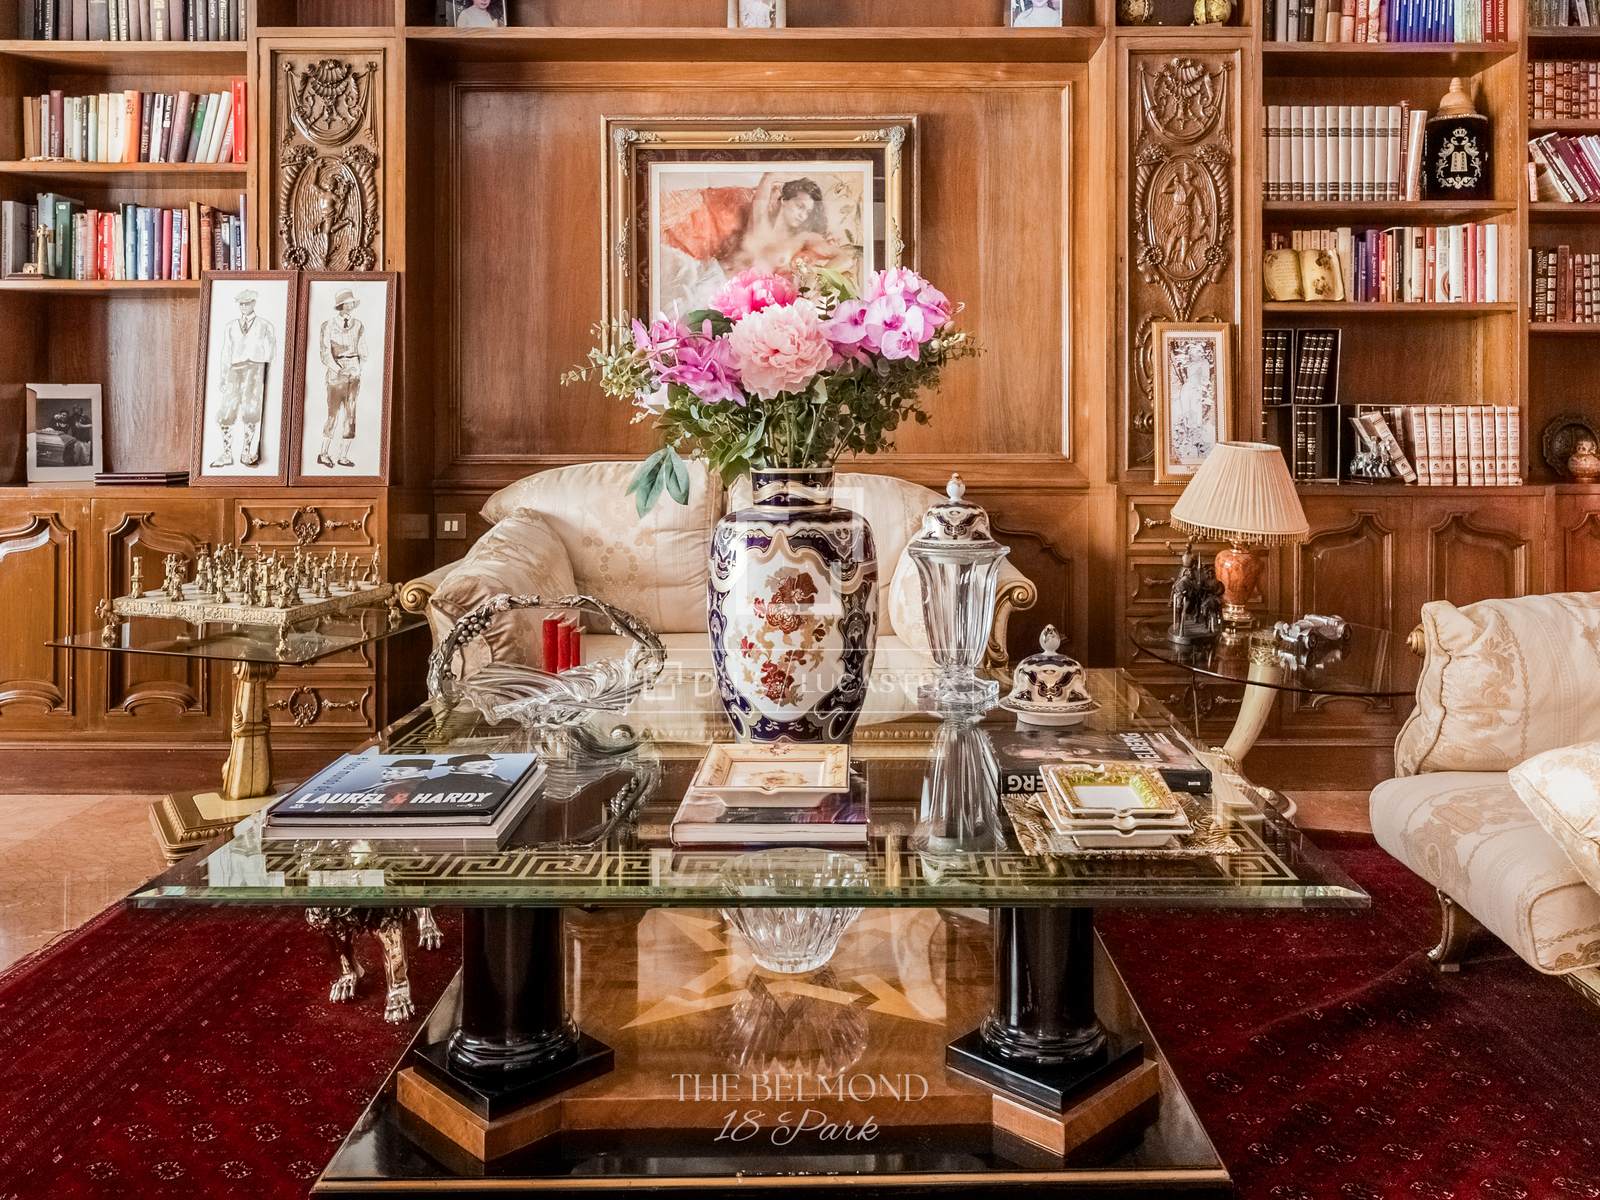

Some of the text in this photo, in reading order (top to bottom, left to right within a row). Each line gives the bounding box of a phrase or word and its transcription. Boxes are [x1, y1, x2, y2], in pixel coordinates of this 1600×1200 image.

[295, 792, 493, 804] LAUREL & HARDY
